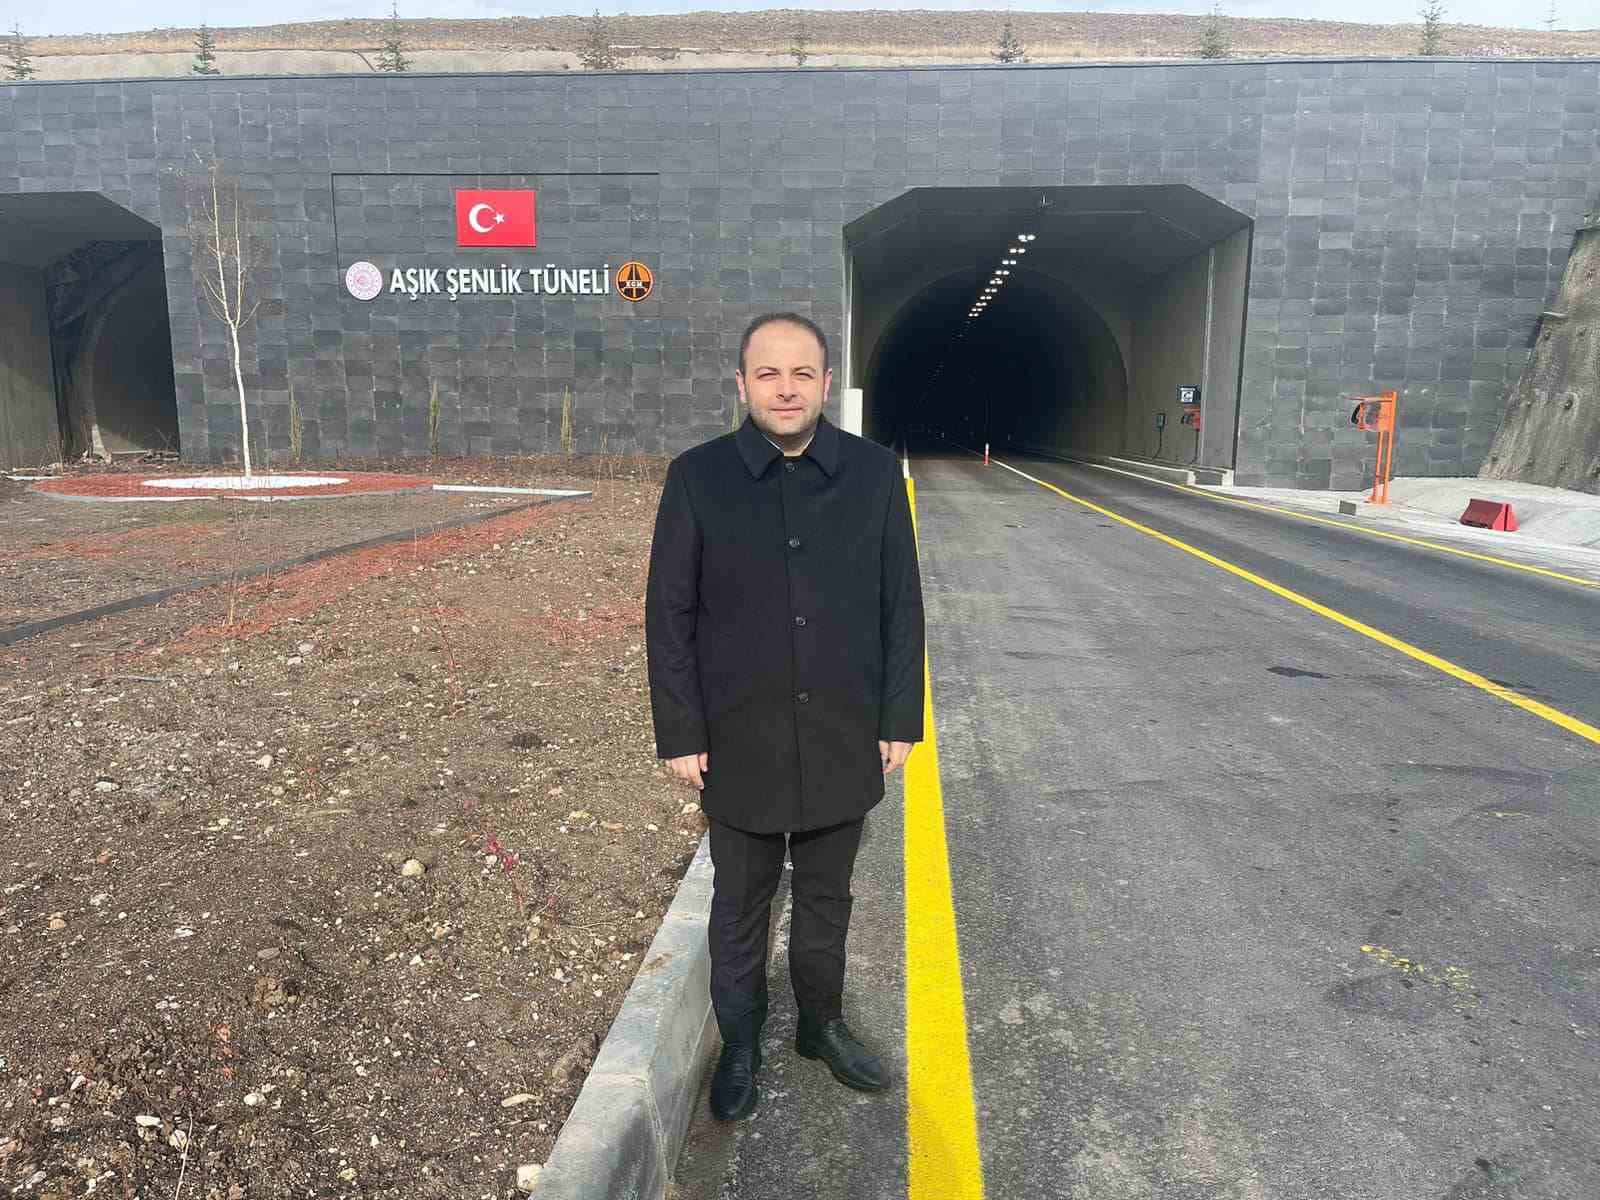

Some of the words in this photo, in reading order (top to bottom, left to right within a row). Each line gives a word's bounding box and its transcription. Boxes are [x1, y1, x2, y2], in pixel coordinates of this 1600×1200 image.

[389, 267, 441, 300] AŞIK
[446, 263, 522, 300] ŞENLİK
[528, 263, 609, 294] TÜNELİ
